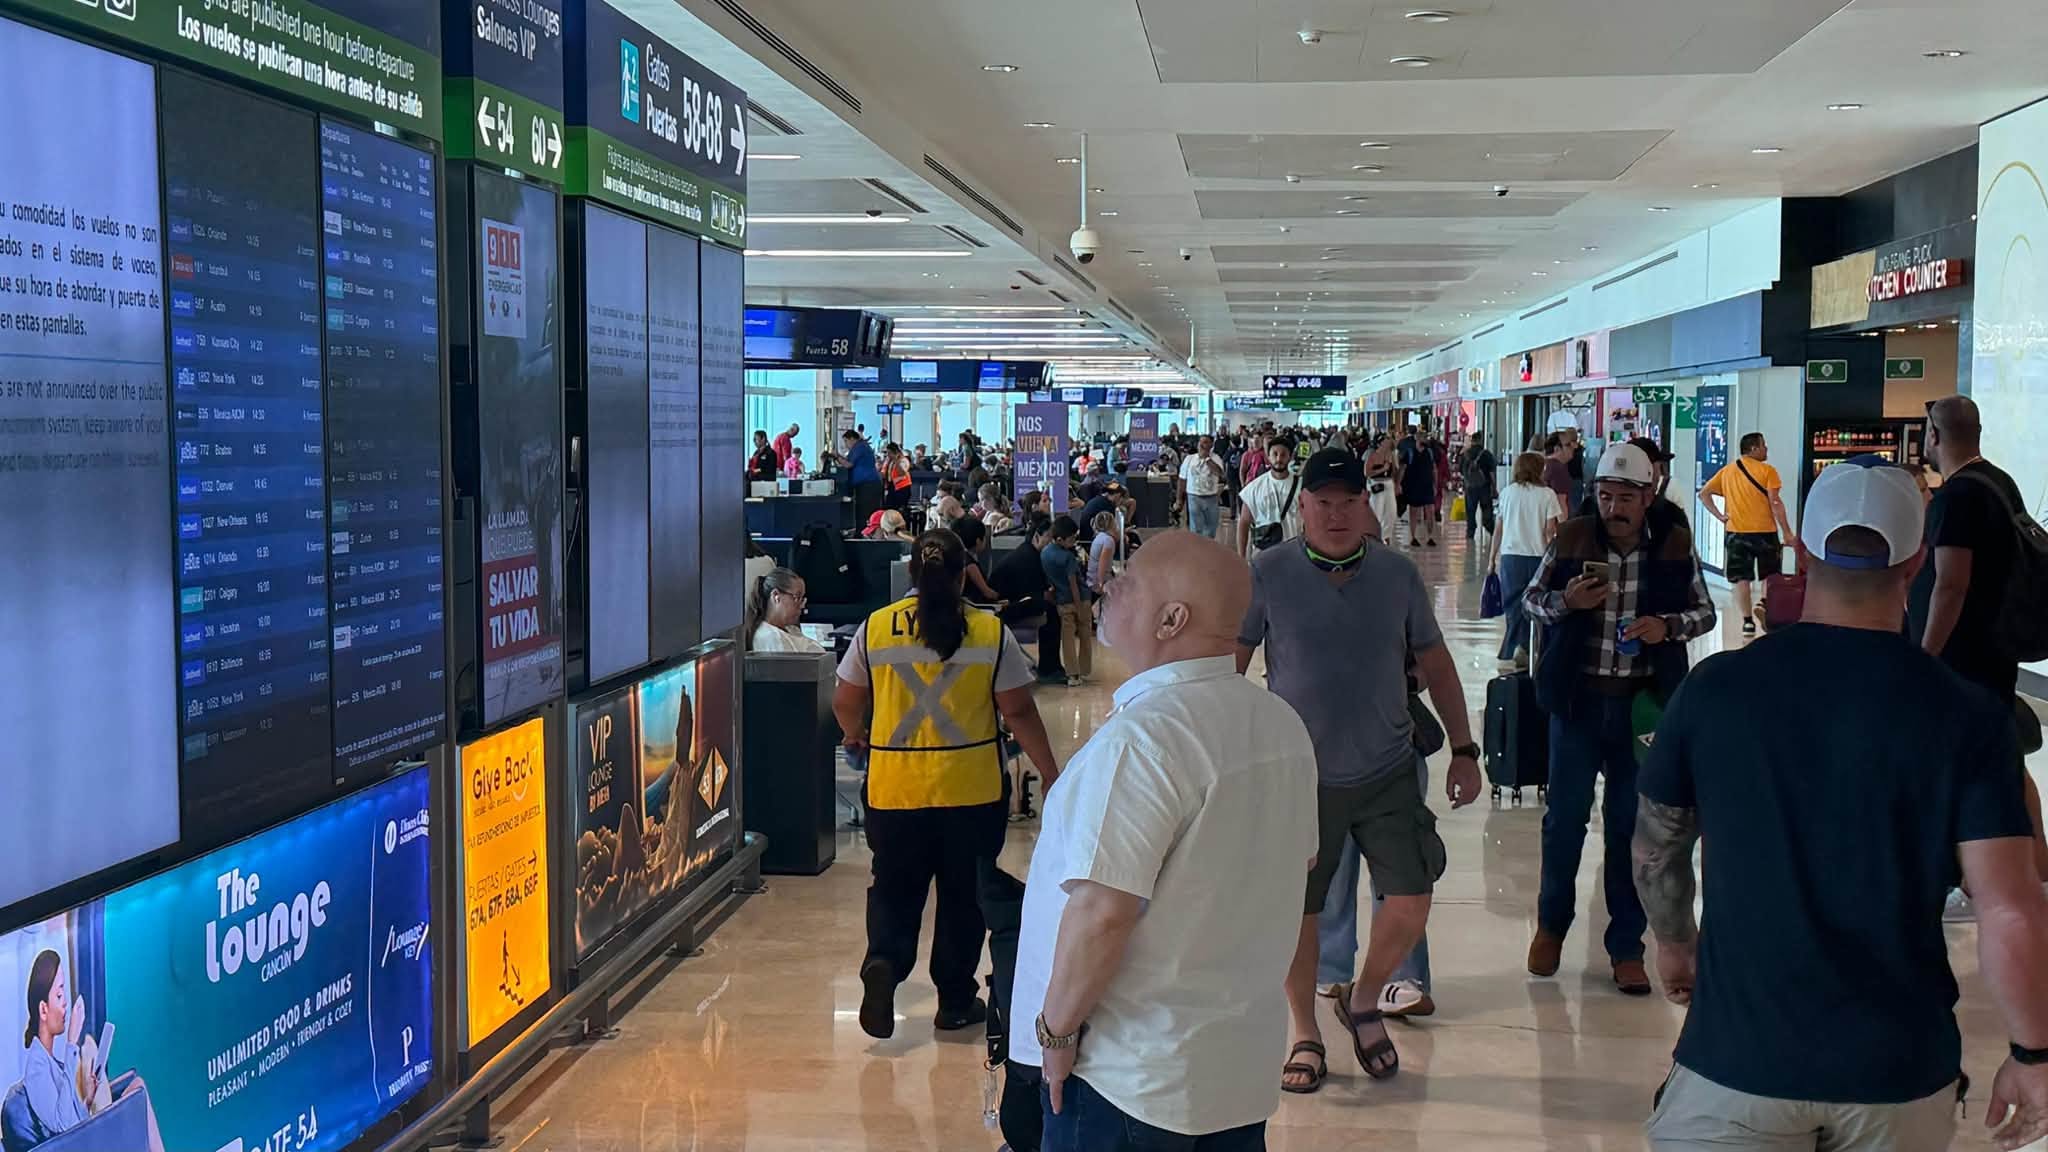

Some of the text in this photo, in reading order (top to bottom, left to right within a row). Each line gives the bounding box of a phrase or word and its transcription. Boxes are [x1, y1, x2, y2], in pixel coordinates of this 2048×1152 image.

[477, 5, 536, 61] Salones VIP
[524, 0, 560, 38] Lounges
[178, 5, 423, 119] Los vuelos se publican una hora antes de su salida
[251, 0, 300, 38] published
[303, 21, 321, 46] one
[323, 21, 345, 56] hour
[346, 31, 374, 67] before
[376, 43, 415, 82] departure
[646, 43, 723, 165] Gates 58-68
[646, 92, 678, 144] Puertas
[497, 101, 546, 166] 54 60
[12, 203, 66, 228] comodidad
[72, 208, 86, 232] los
[91, 215, 120, 237] vuelos
[125, 223, 137, 240] no
[142, 227, 158, 243] son
[31, 242, 44, 260] en
[53, 240, 62, 262] el
[70, 244, 104, 269] sistema
[112, 251, 123, 271] de
[131, 257, 158, 279] voceo,
[489, 233, 518, 265] 911
[1913, 243, 1932, 264] PUCK
[15, 277, 27, 294] su
[30, 274, 52, 297] hora
[56, 277, 68, 299] de
[71, 280, 106, 303] abordar
[109, 288, 115, 309] y
[118, 290, 146, 309] puerta
[149, 289, 160, 310] de
[1865, 259, 1947, 303] KITCHEN COUNTER
[15, 313, 40, 333] estas
[43, 313, 88, 337] pantallas.
[805, 338, 849, 356] Puerta 58
[7, 381, 23, 398] are
[26, 379, 42, 399] not
[46, 378, 97, 400] announced
[99, 383, 118, 401] over
[121, 380, 136, 401] the
[1018, 416, 1042, 432] NOS
[1018, 458, 1065, 477] MÉXCO
[488, 512, 498, 530] LA
[489, 566, 539, 607] SALVAR
[489, 606, 540, 649] TU VIDA
[590, 715, 612, 765] VIP
[472, 751, 534, 801] Give Back
[588, 761, 613, 792] LOUNGE
[217, 868, 260, 919] The
[207, 973, 352, 1081] UNLIMITED FOOD & DRINKS
[402, 1025, 413, 1067] P
[208, 999, 353, 1109] PLEASANT MODERN FRIENDLY & COZY
[296, 1104, 318, 1149] 54
